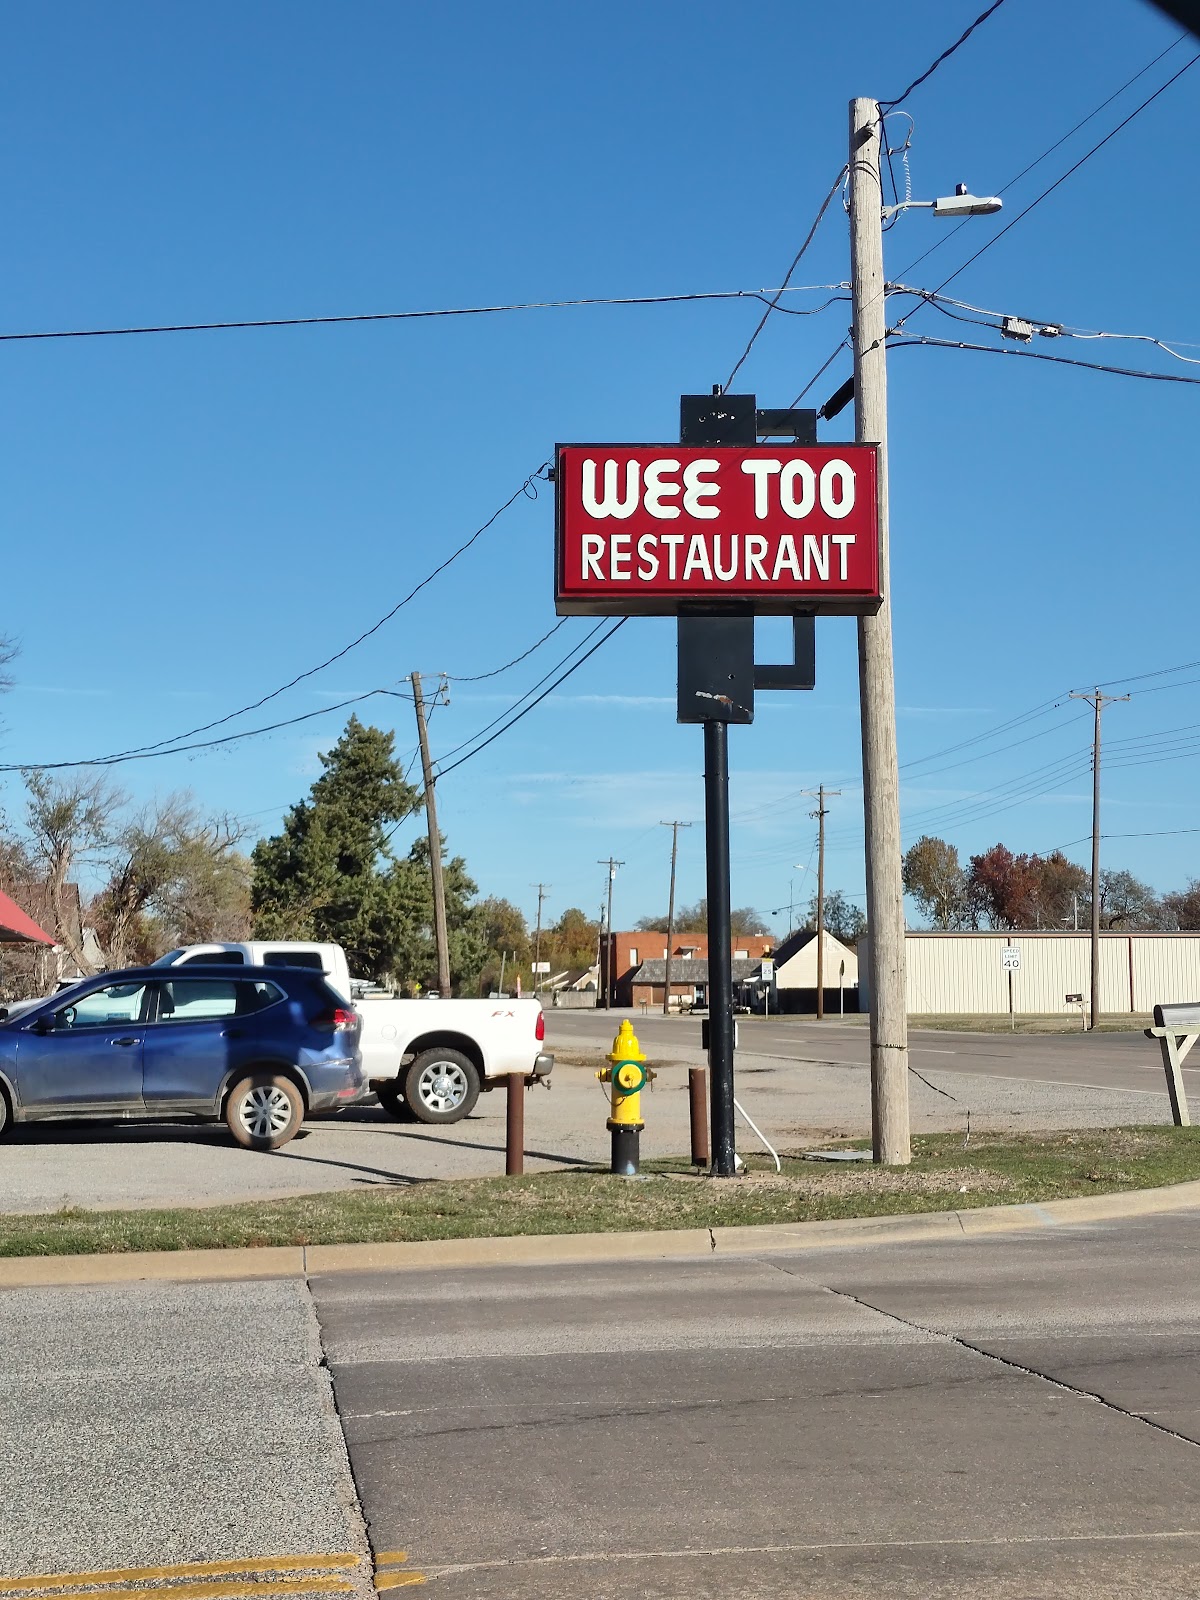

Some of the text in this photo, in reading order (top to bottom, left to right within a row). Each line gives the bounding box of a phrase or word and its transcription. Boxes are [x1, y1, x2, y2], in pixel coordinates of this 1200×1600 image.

[582, 459, 856, 519] WEE TOO
[581, 534, 856, 581] RESTAURANT
